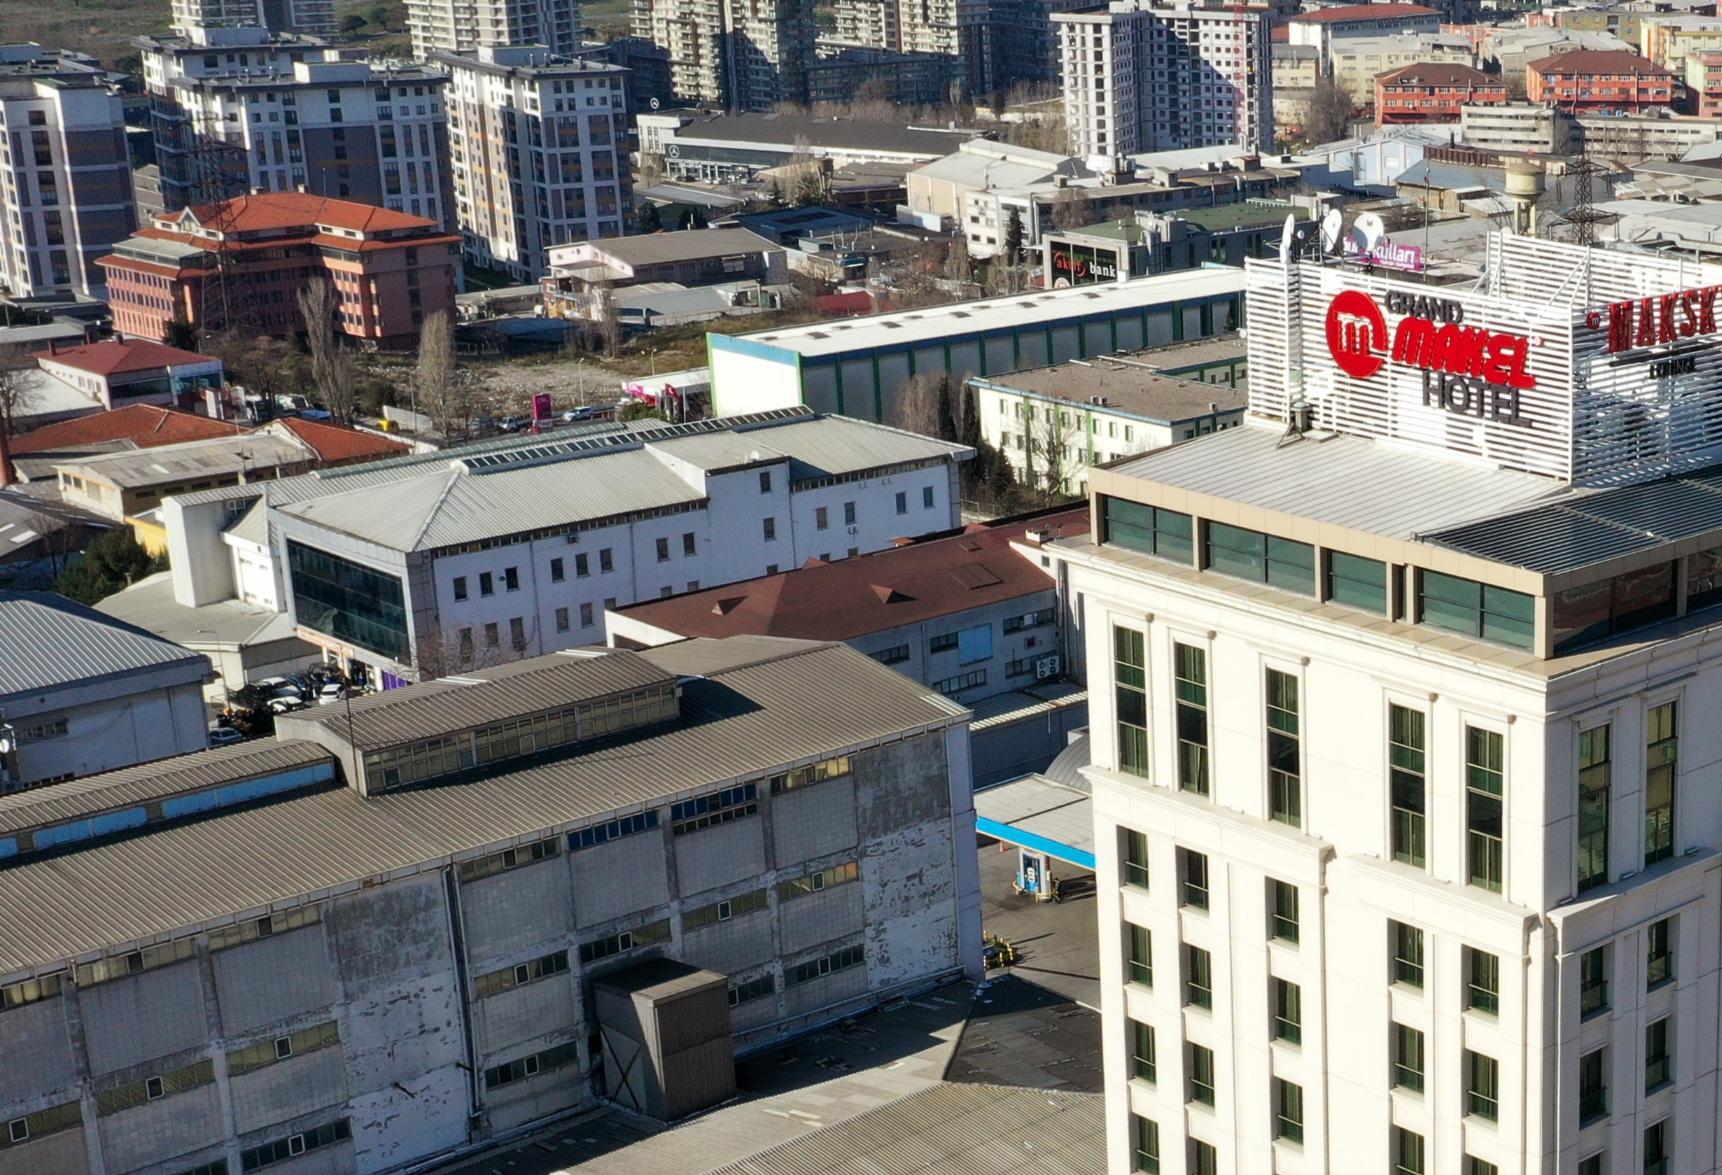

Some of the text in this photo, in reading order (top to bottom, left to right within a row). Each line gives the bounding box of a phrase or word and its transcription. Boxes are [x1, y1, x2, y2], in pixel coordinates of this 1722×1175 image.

[1089, 261, 1116, 278] bank
[1384, 290, 1464, 324] GRAND
[1392, 317, 1537, 390] MAKEL
[1422, 369, 1533, 428] HOTEL
